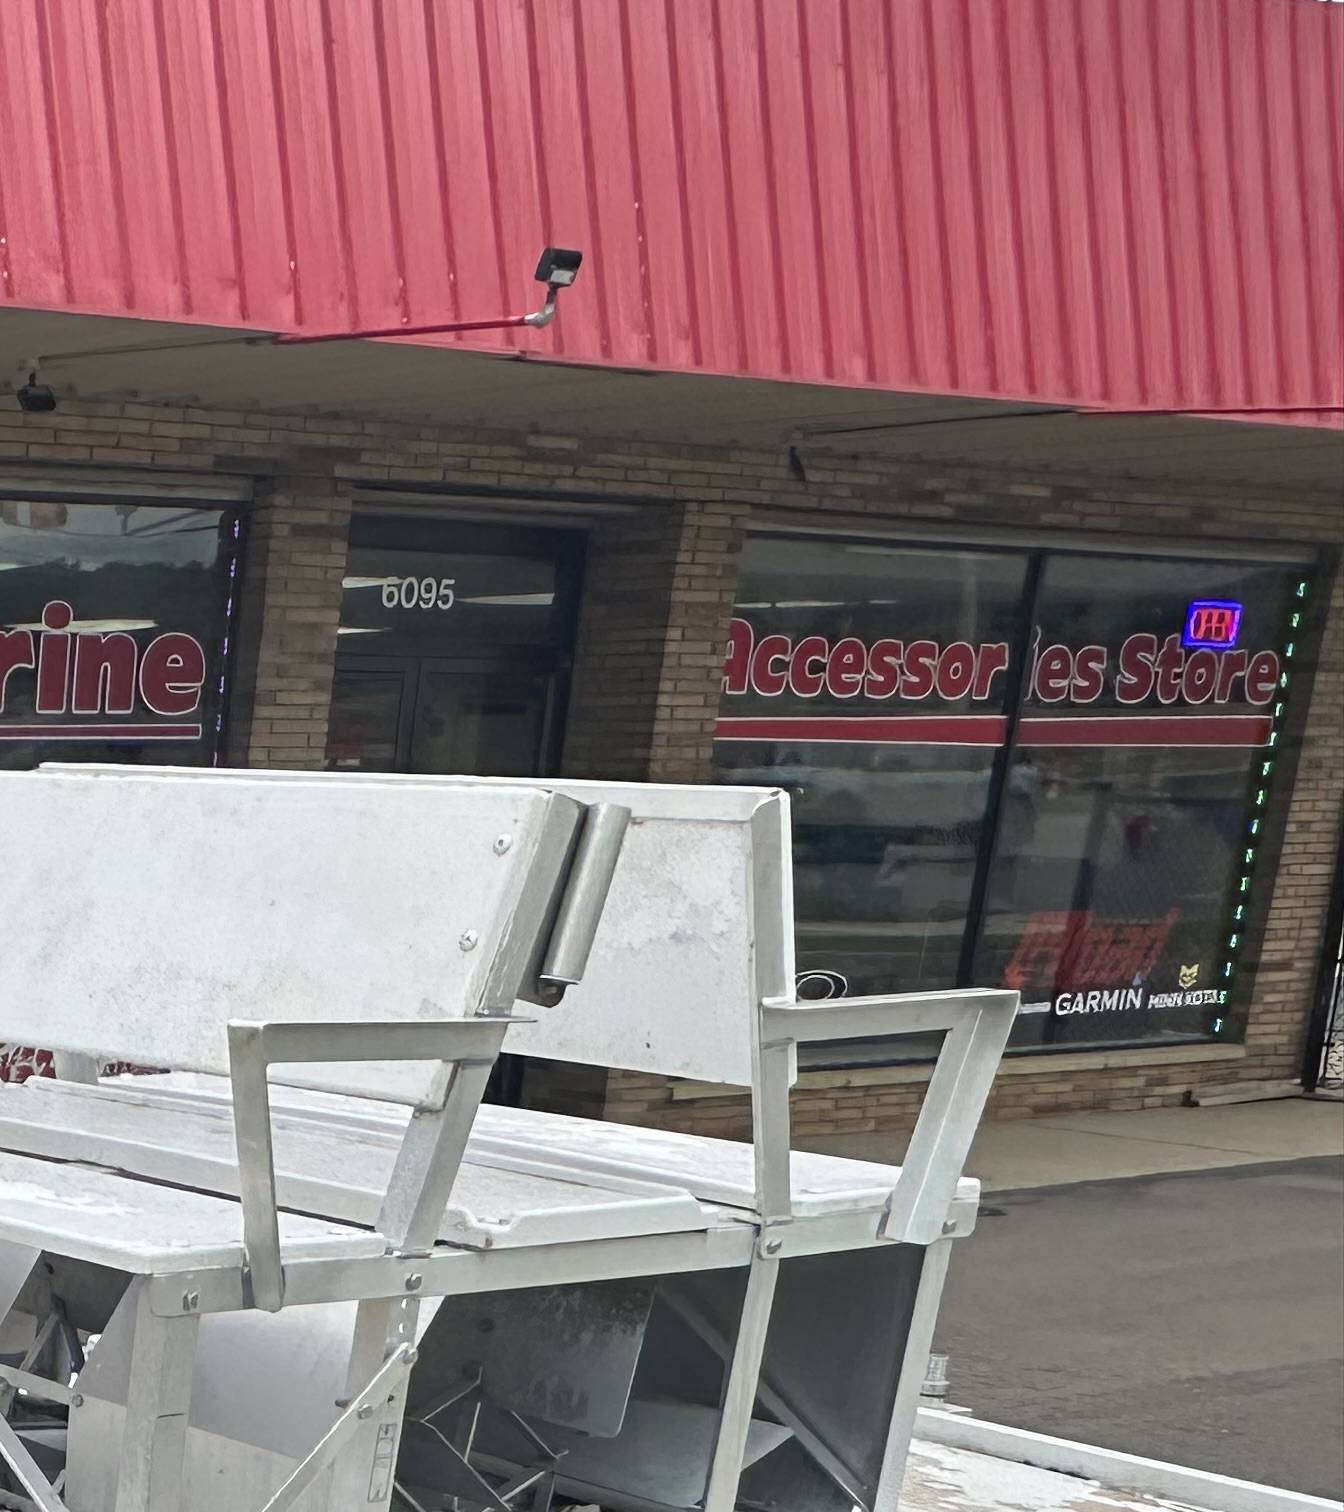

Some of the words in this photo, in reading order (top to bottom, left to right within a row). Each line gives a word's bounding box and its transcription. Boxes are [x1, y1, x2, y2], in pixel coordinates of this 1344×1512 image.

[382, 576, 456, 610] 6095
[720, 617, 1107, 703] Accessores
[1115, 633, 1279, 705] Store
[1055, 988, 1145, 1016] GARMIN
